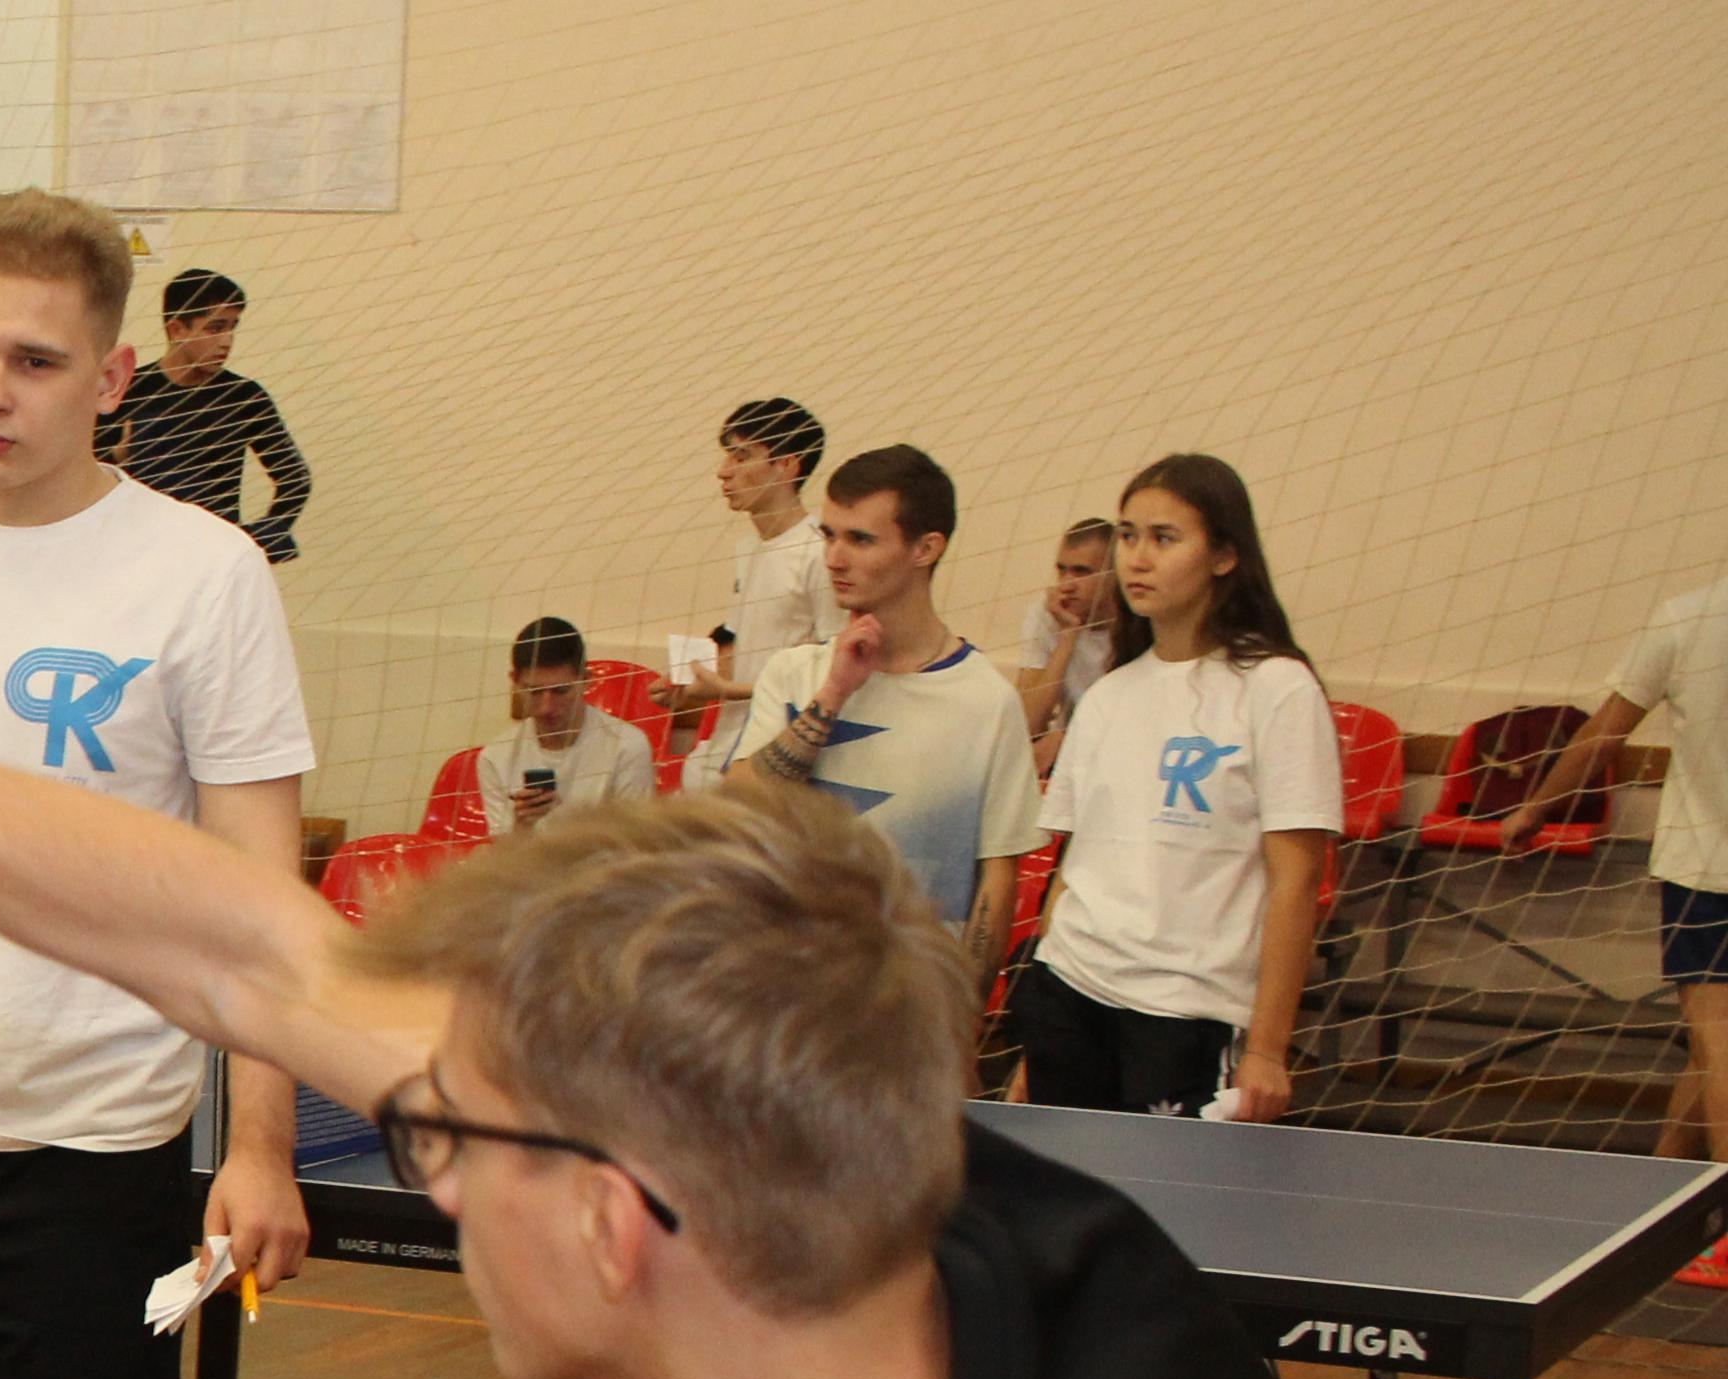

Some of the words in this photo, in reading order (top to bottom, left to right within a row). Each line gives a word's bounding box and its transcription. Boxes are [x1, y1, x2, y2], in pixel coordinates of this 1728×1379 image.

[337, 1238, 379, 1254] MADE
[381, 1242, 397, 1255] IN
[399, 1244, 458, 1261] GERMAN
[1278, 1320, 1427, 1361] STIGA
